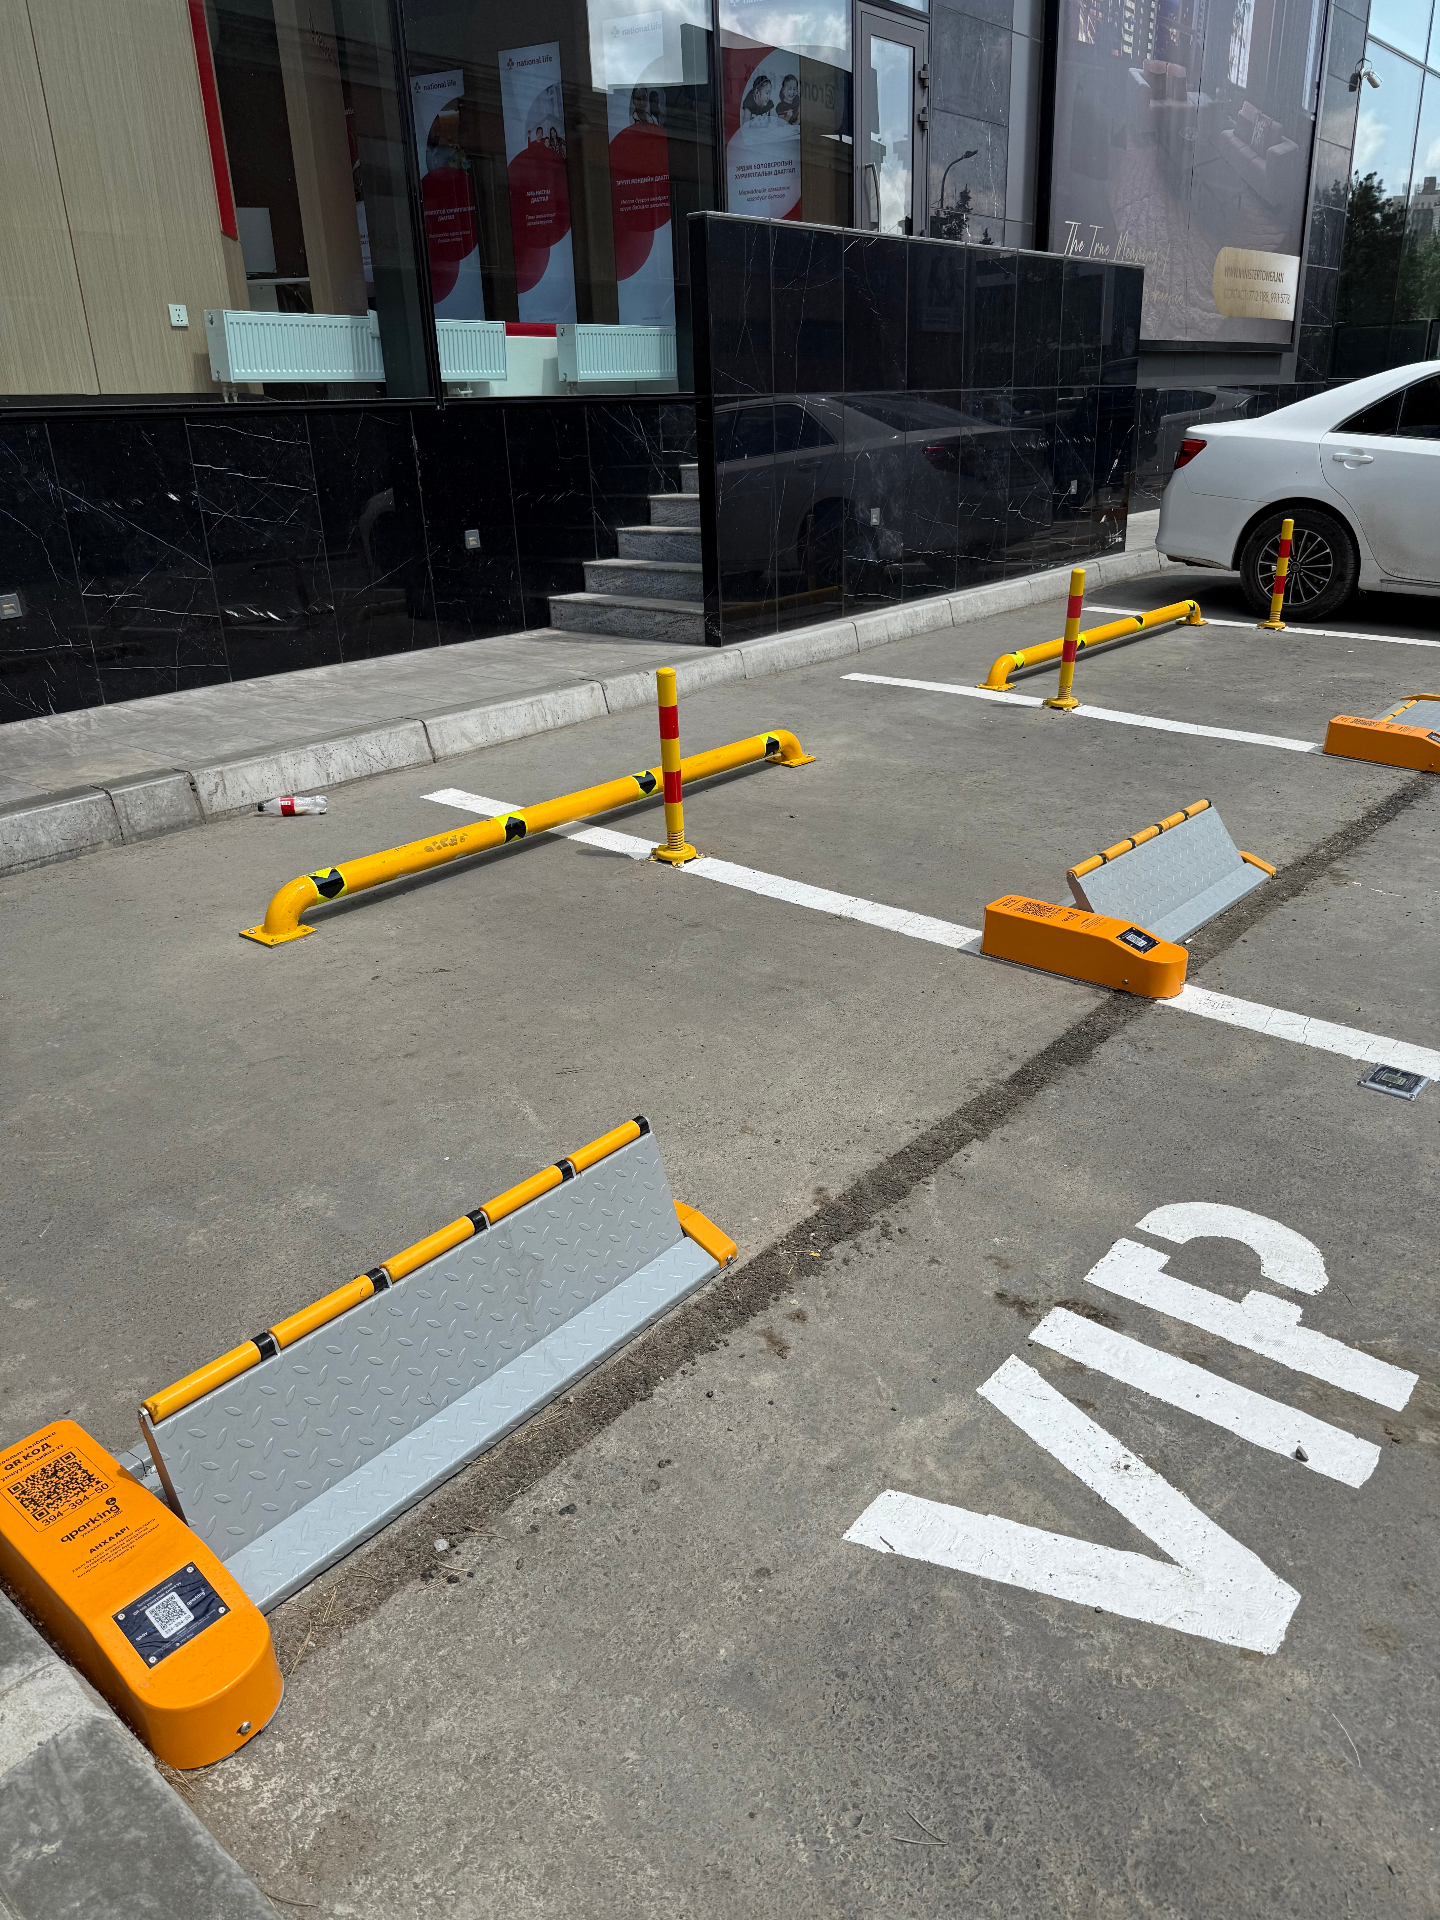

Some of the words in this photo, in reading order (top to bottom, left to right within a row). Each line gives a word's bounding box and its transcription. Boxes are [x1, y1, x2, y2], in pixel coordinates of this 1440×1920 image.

[622, 23, 650, 36] national
[650, 22, 662, 31] life
[516, 56, 541, 67] national
[542, 54, 552, 63] life
[423, 80, 446, 91] national
[447, 79, 457, 87] life
[1064, 220, 1085, 256] The
[842, 1202, 1420, 1655] VIP
[4, 1459, 22, 1471] QR
[22, 1442, 52, 1460] КОД
[60, 1504, 120, 1543] qparking
